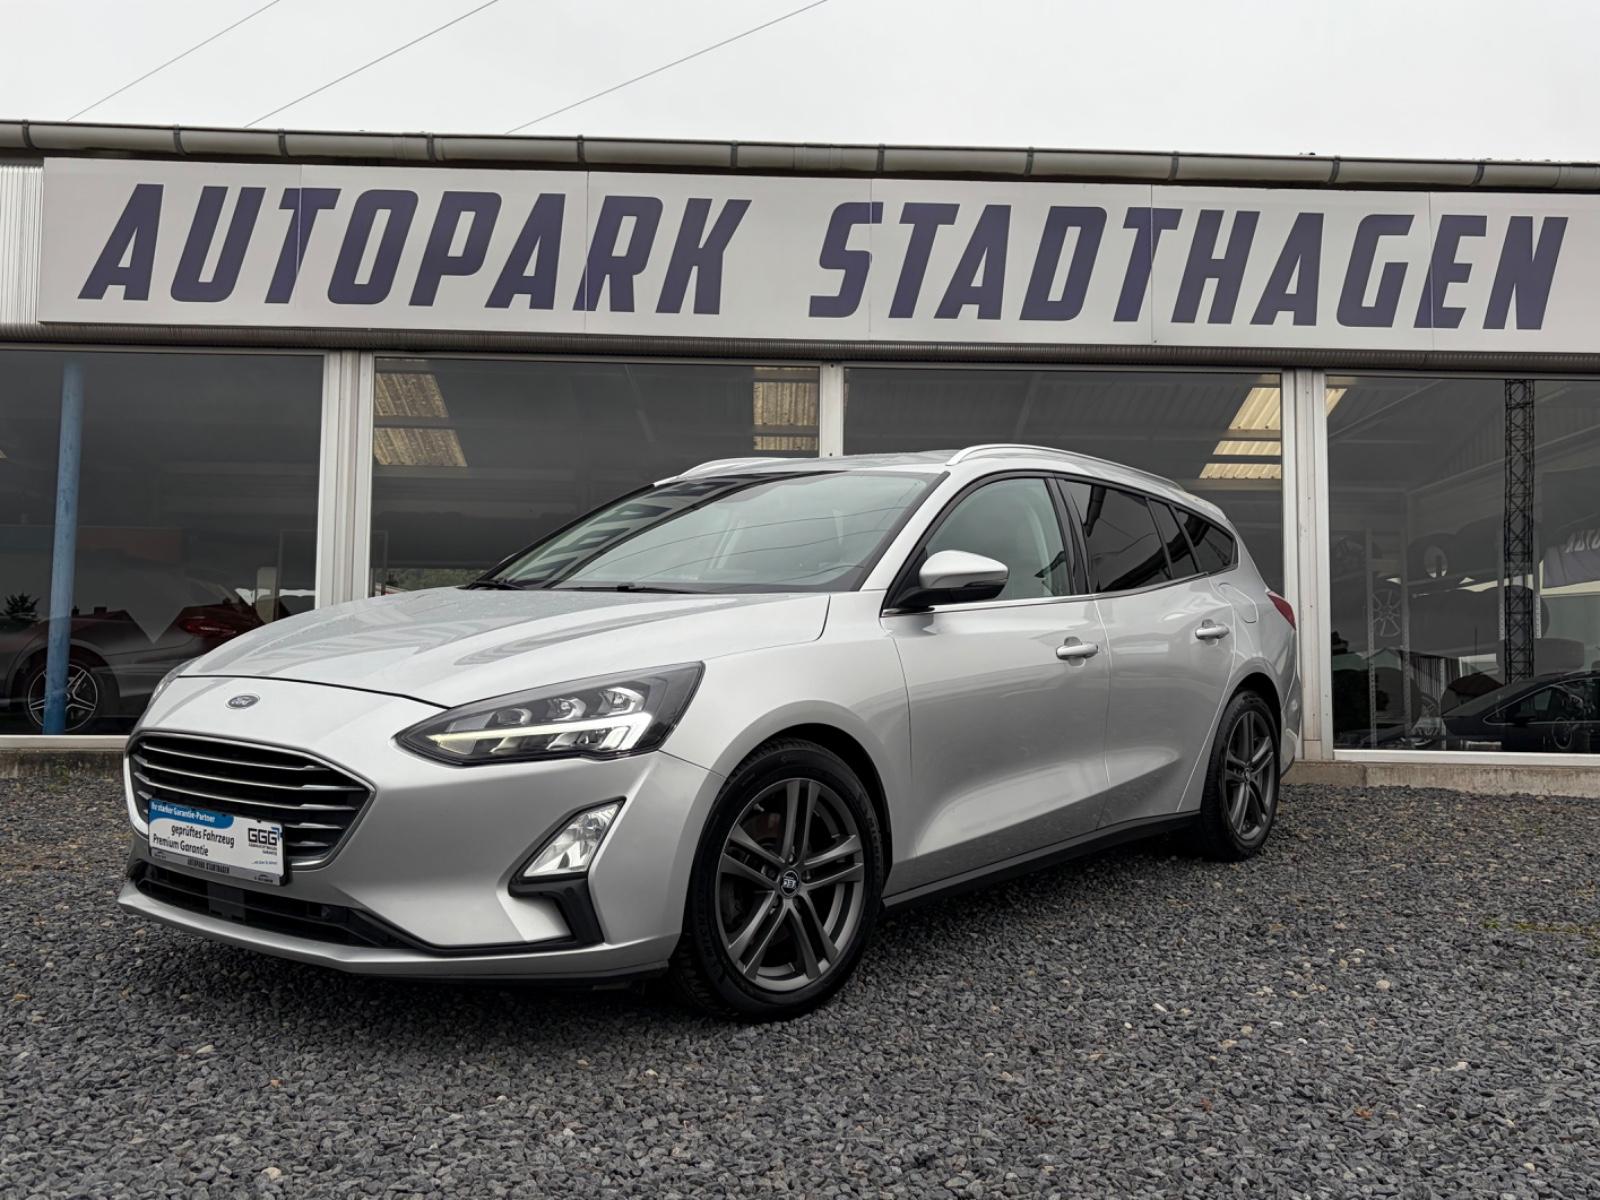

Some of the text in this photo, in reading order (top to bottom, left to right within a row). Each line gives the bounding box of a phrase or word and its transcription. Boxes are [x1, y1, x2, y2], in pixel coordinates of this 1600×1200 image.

[78, 184, 1568, 331] AUTOPARK STADTHAGEN
[173, 808, 216, 822] Garantie-Partner
[153, 833, 179, 850] Premium
[180, 840, 209, 856] Garantie
[171, 825, 202, 840] geprüftes
[202, 829, 234, 847] Fahrzeug
[247, 827, 278, 846] GGG
